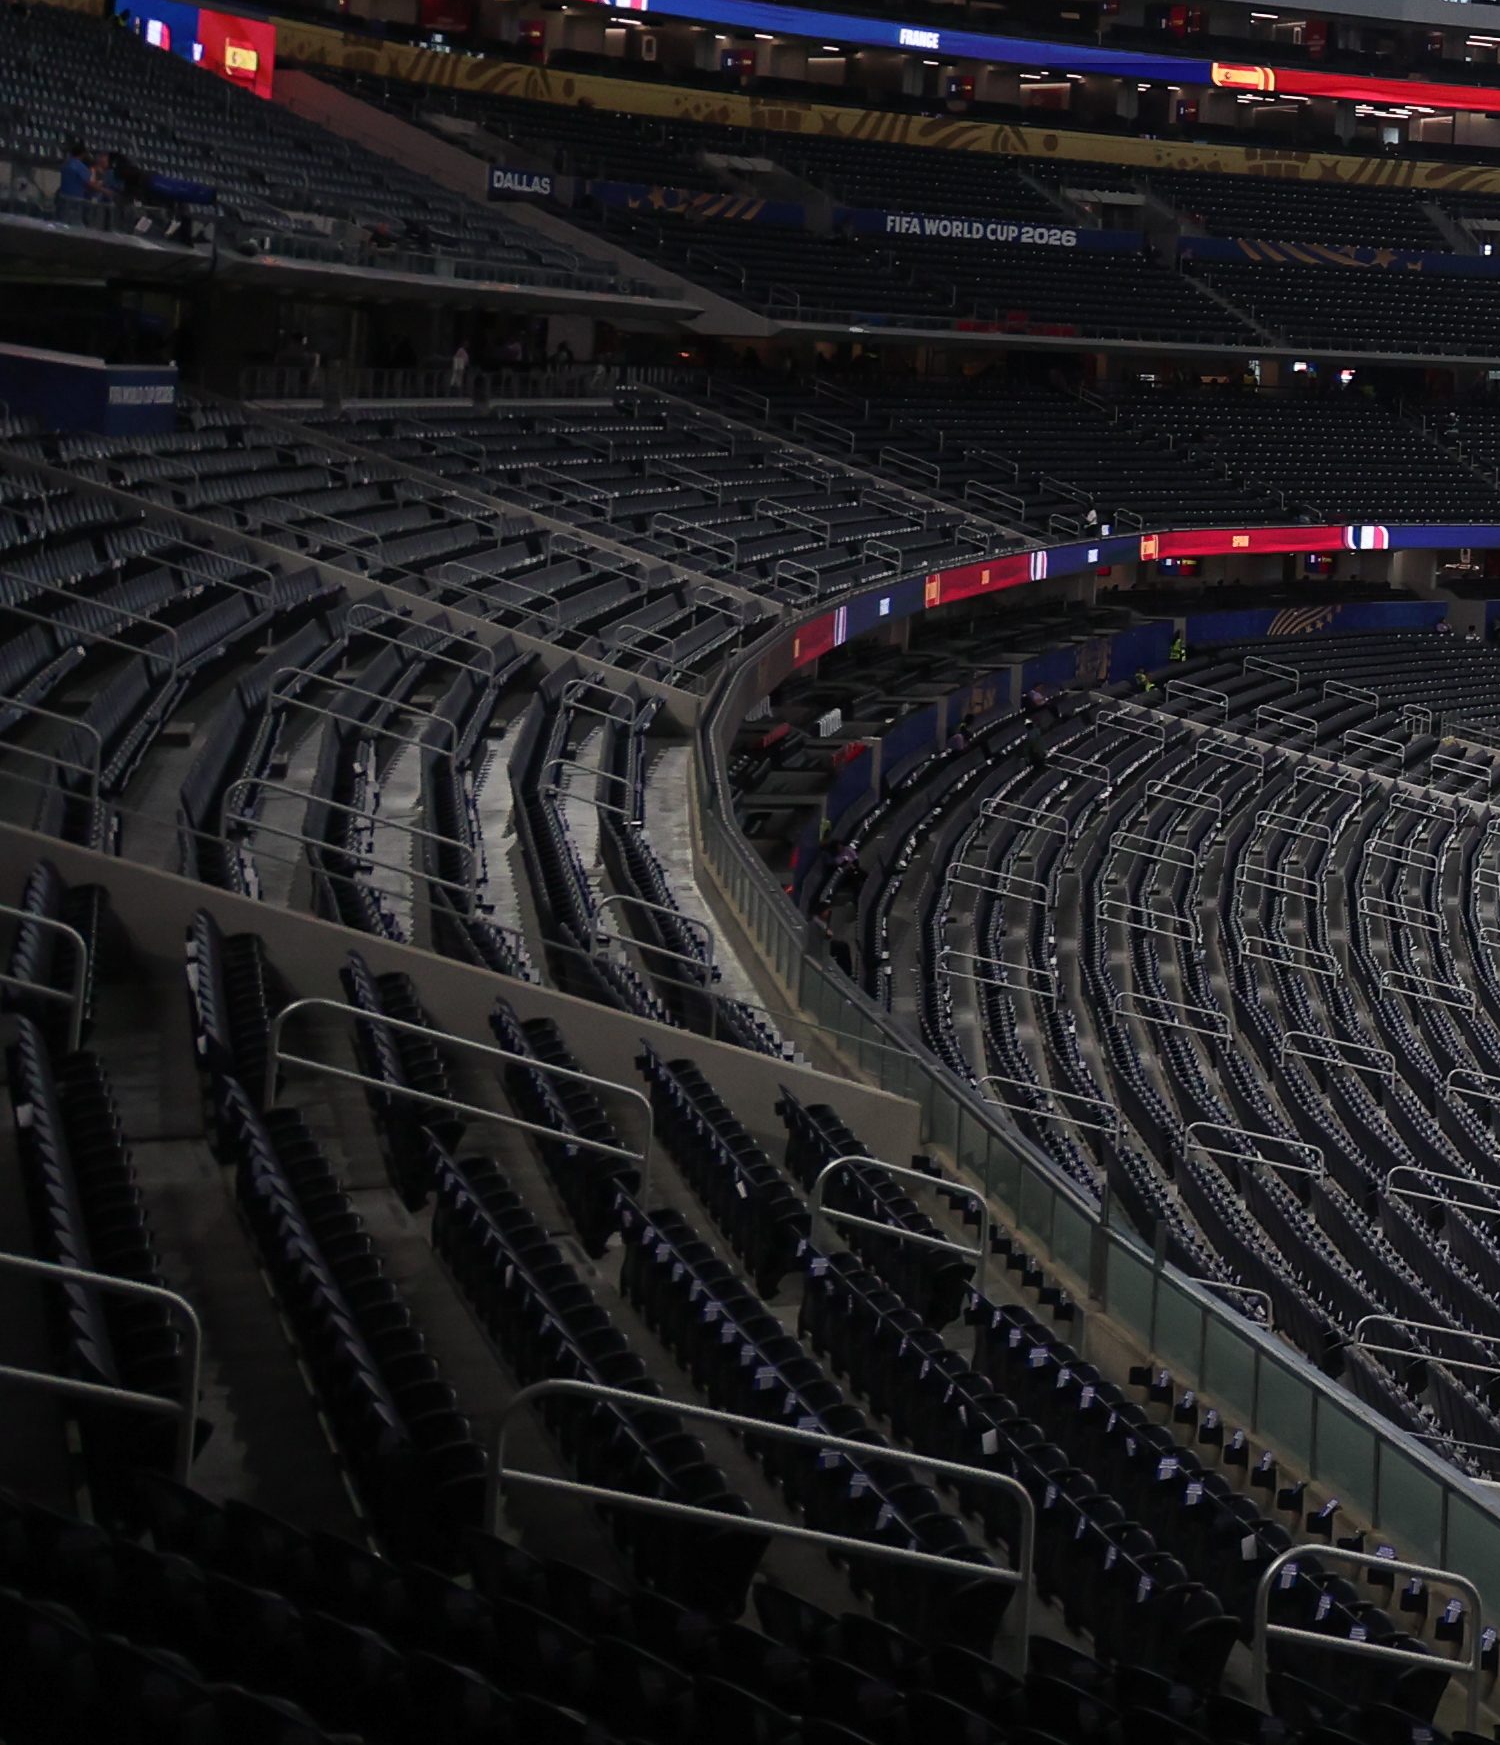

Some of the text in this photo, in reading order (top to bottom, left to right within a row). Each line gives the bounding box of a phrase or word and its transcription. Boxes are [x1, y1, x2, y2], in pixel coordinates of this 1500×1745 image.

[900, 29, 939, 48] FRANCE
[494, 171, 550, 194] DALLAS
[887, 216, 1076, 246] FIFA WORLD CUP 2026
